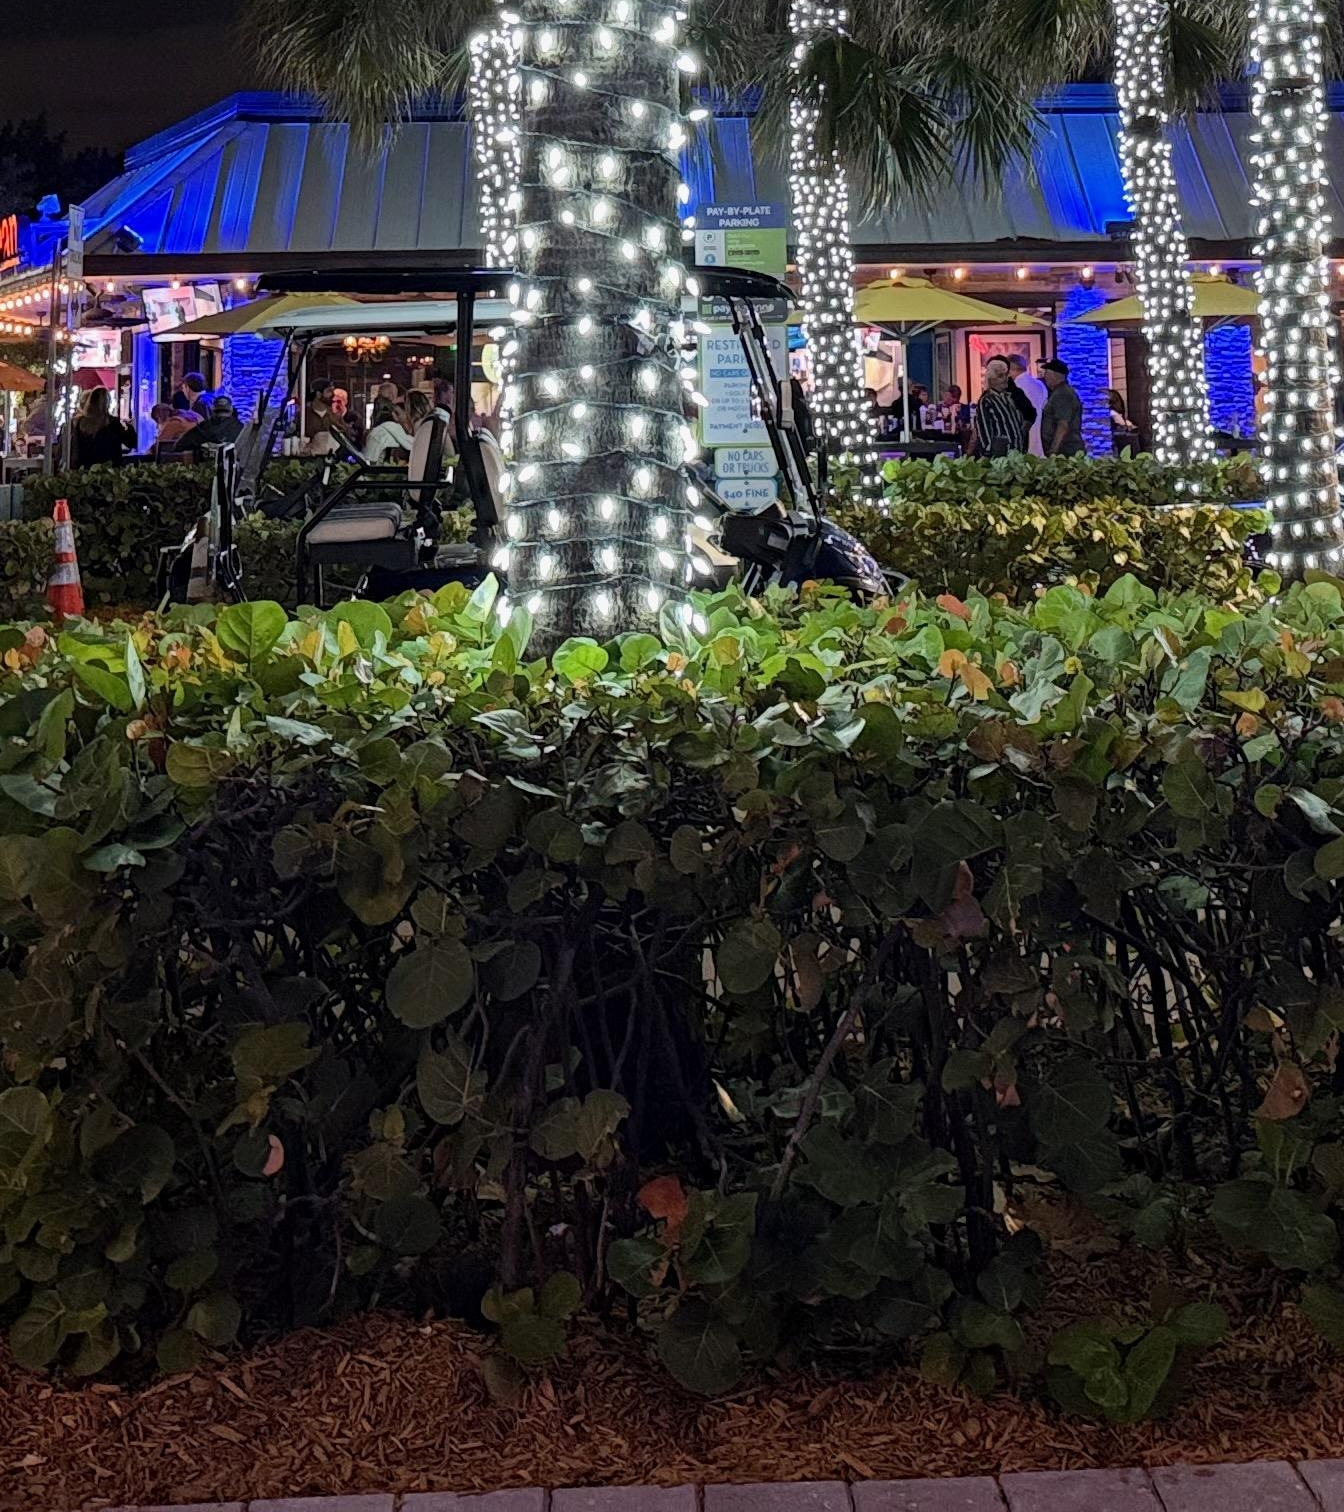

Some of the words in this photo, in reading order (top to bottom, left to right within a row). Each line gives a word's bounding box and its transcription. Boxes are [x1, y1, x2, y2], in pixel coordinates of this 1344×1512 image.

[706, 205, 771, 216] PAY-BY-PLATE
[718, 218, 760, 227] PARKING
[727, 450, 740, 461] NO
[743, 450, 764, 461] CARS
[722, 462, 735, 473] OR
[736, 462, 769, 473] TRUCKS
[724, 490, 743, 499] $40
[745, 489, 769, 498] FINE
